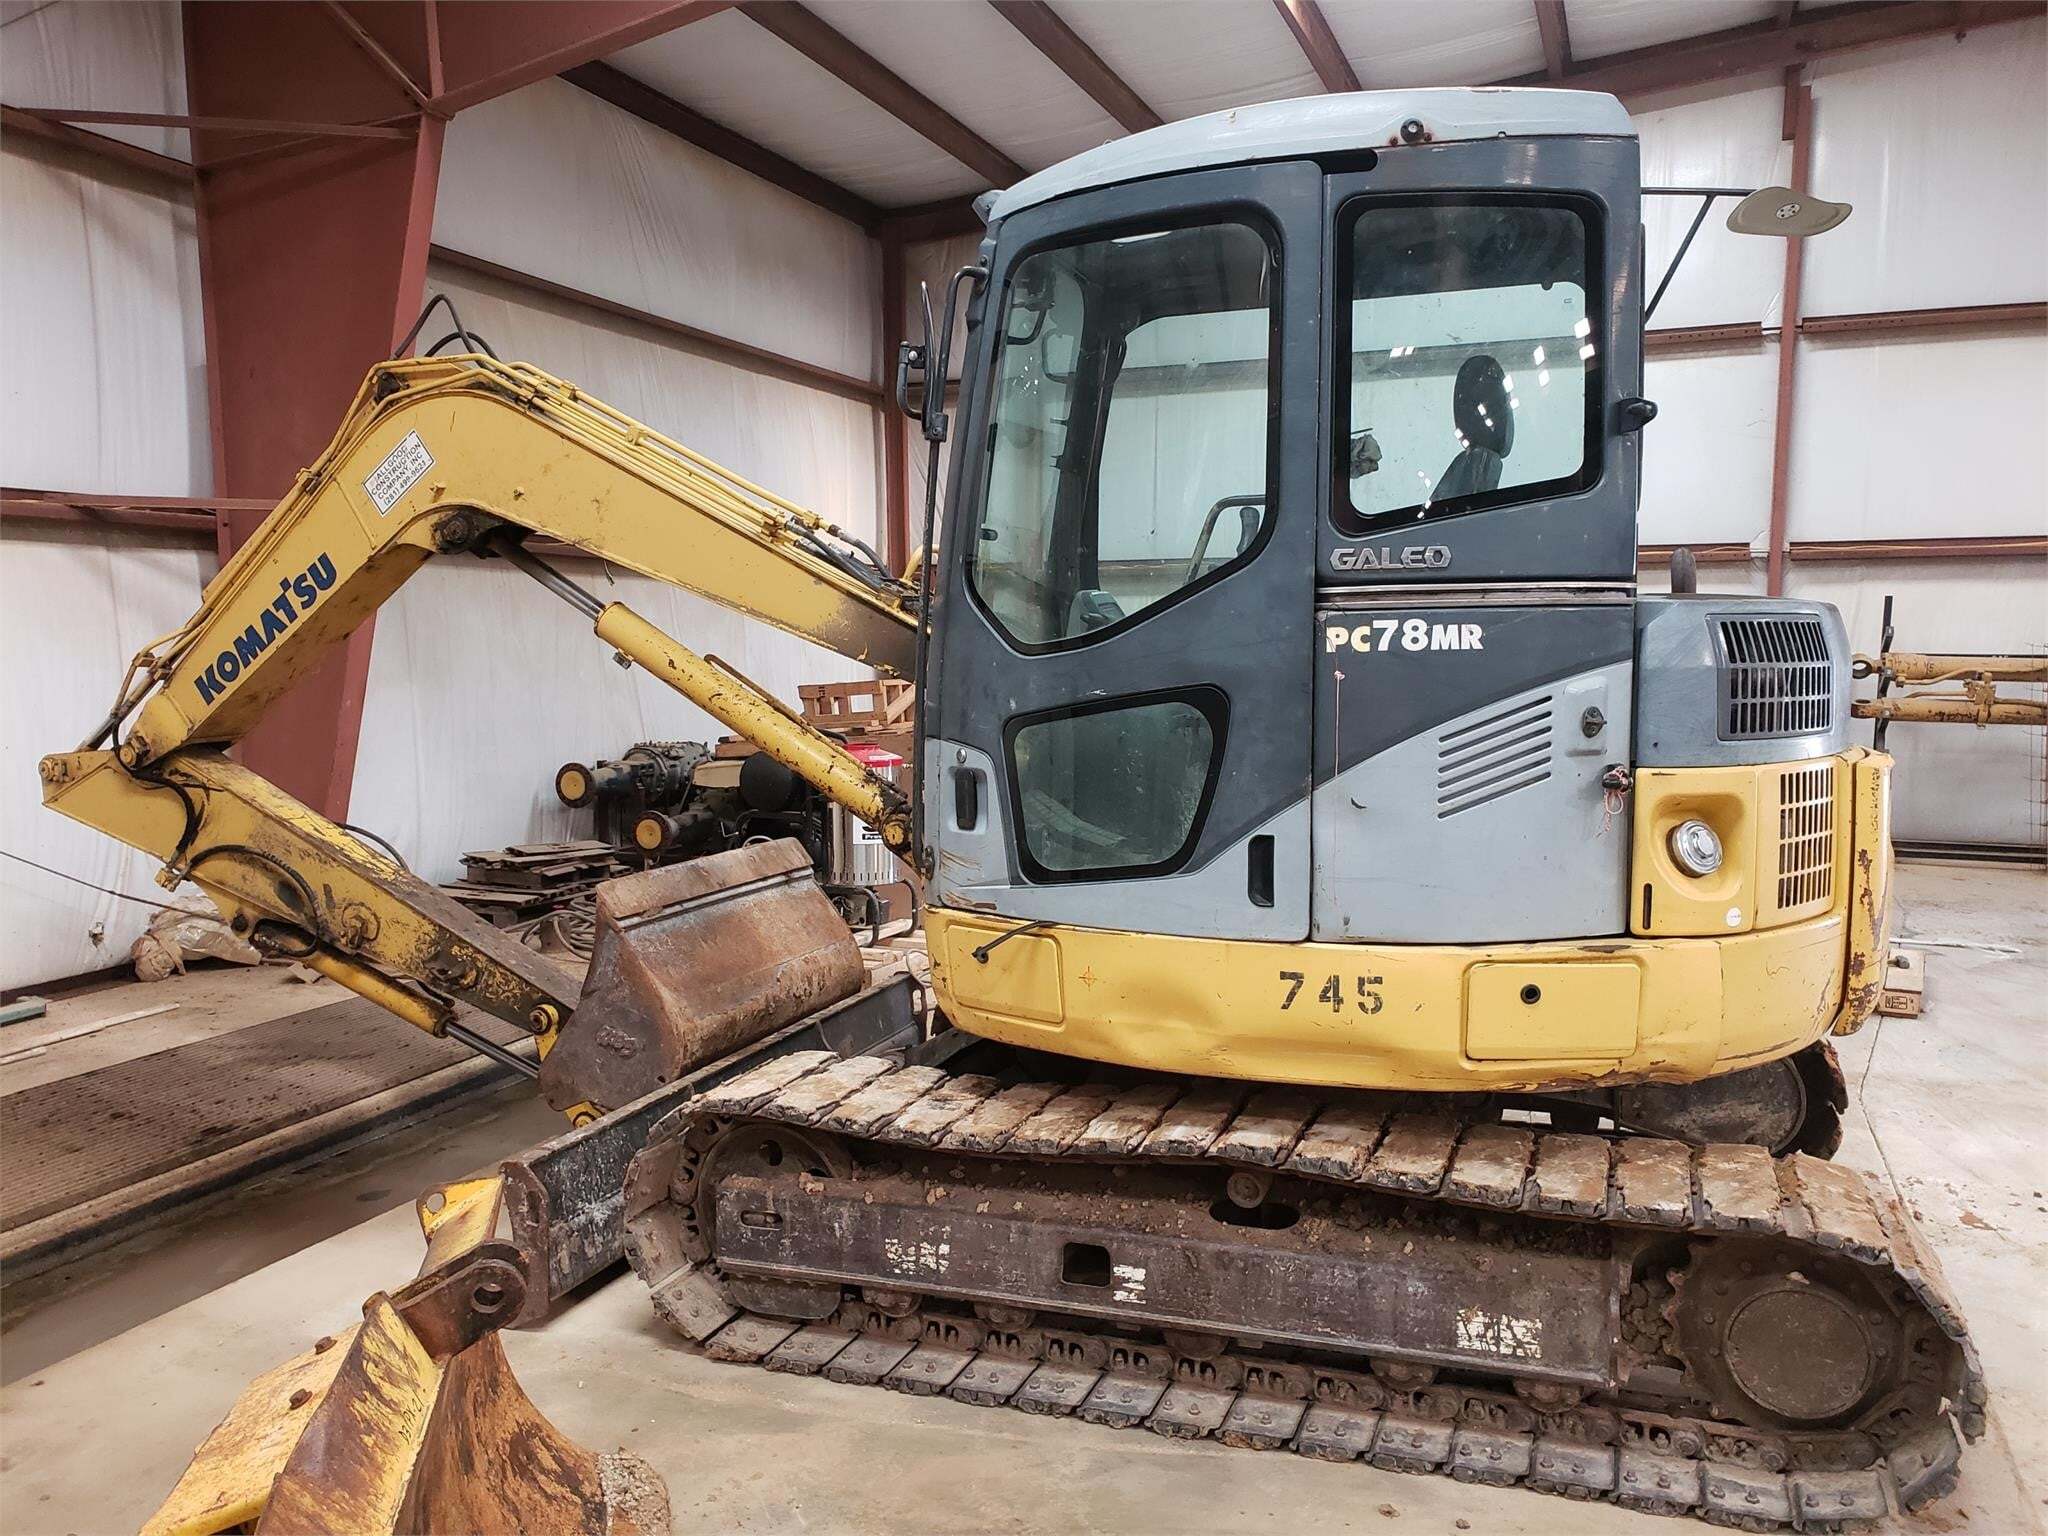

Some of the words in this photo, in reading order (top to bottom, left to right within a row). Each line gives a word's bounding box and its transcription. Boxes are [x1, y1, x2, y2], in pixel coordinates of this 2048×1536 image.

[371, 442, 421, 495] CONSTRUCTION
[383, 487, 400, 506] (281)
[1329, 545, 1452, 571] GALEO
[193, 552, 337, 706] KOMATSU
[1325, 618, 1484, 653] PC78MR
[1280, 971, 1383, 1014] 745
